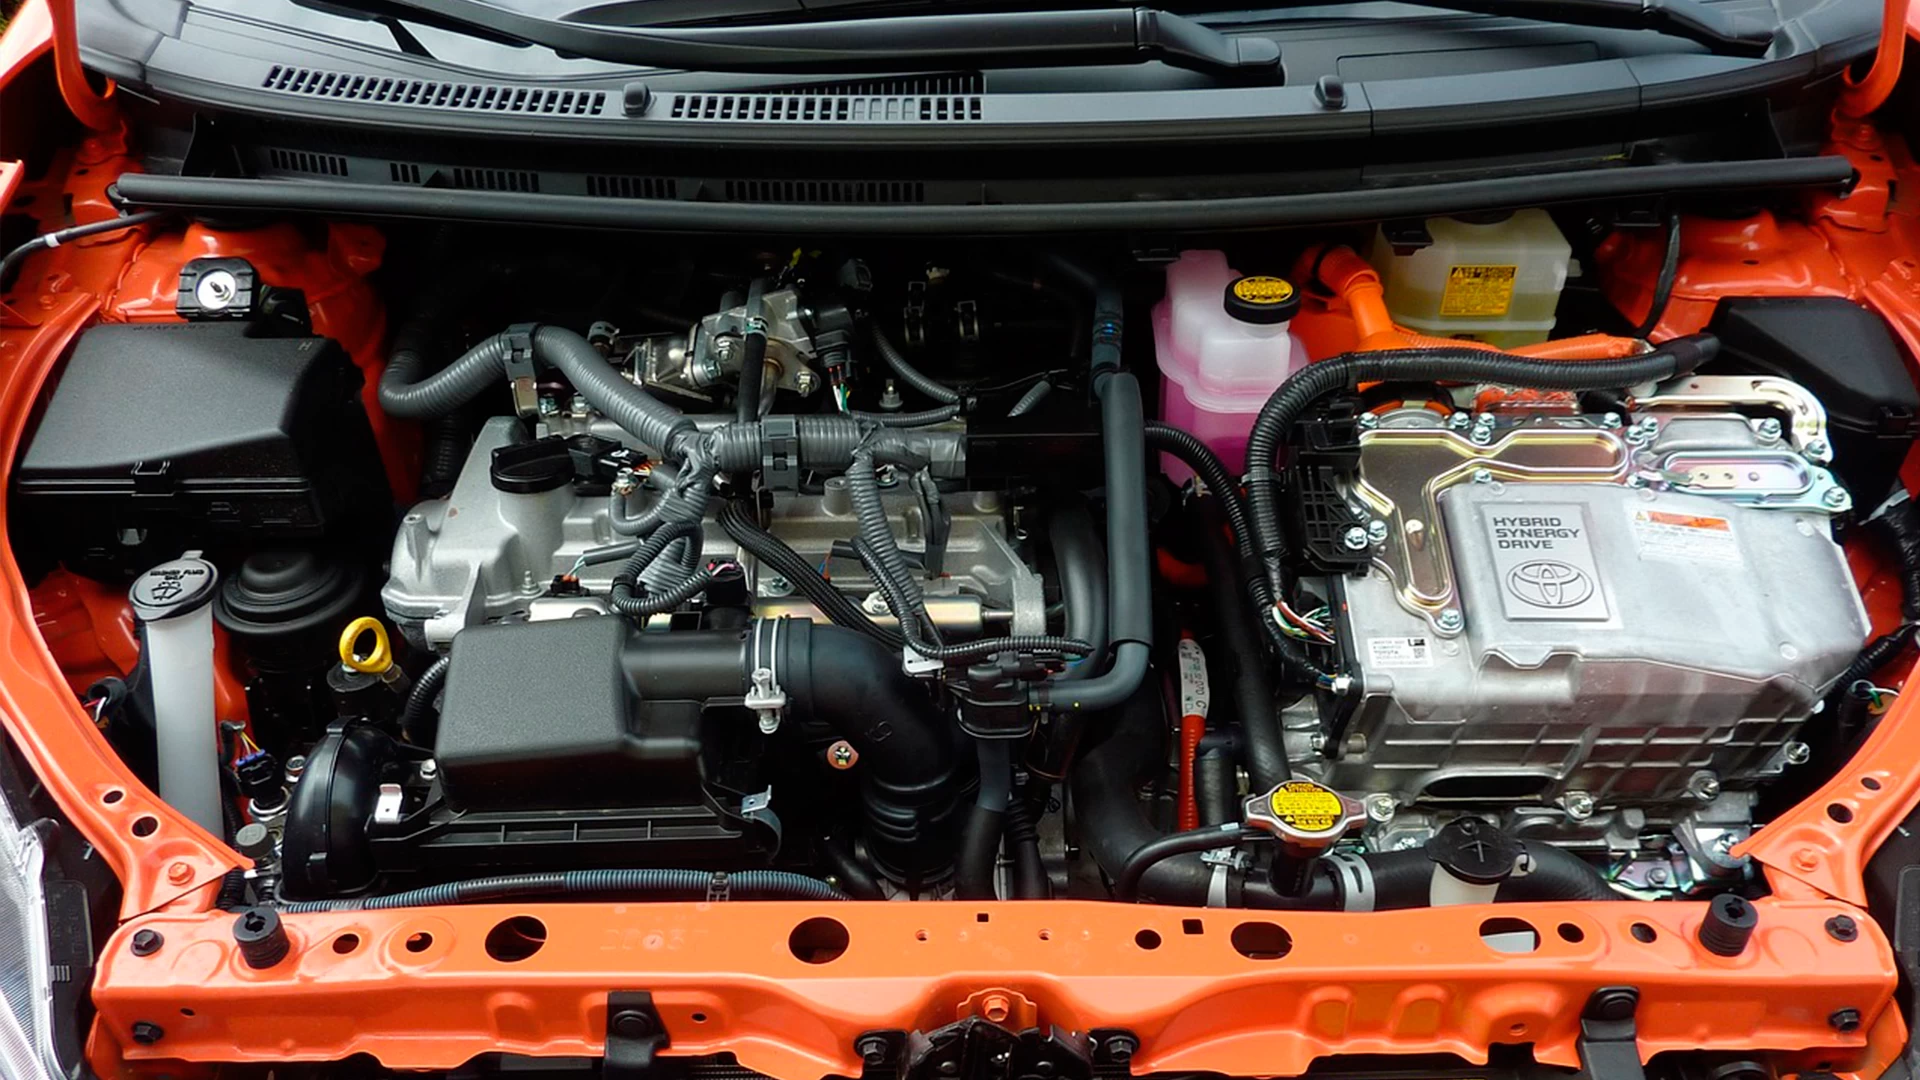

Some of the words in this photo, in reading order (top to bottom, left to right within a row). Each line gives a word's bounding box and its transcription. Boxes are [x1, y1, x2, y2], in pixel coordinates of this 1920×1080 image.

[1493, 517, 1562, 527] HYBRID
[1495, 528, 1580, 538] SYNERGY
[1498, 540, 1554, 549] DRIVE
